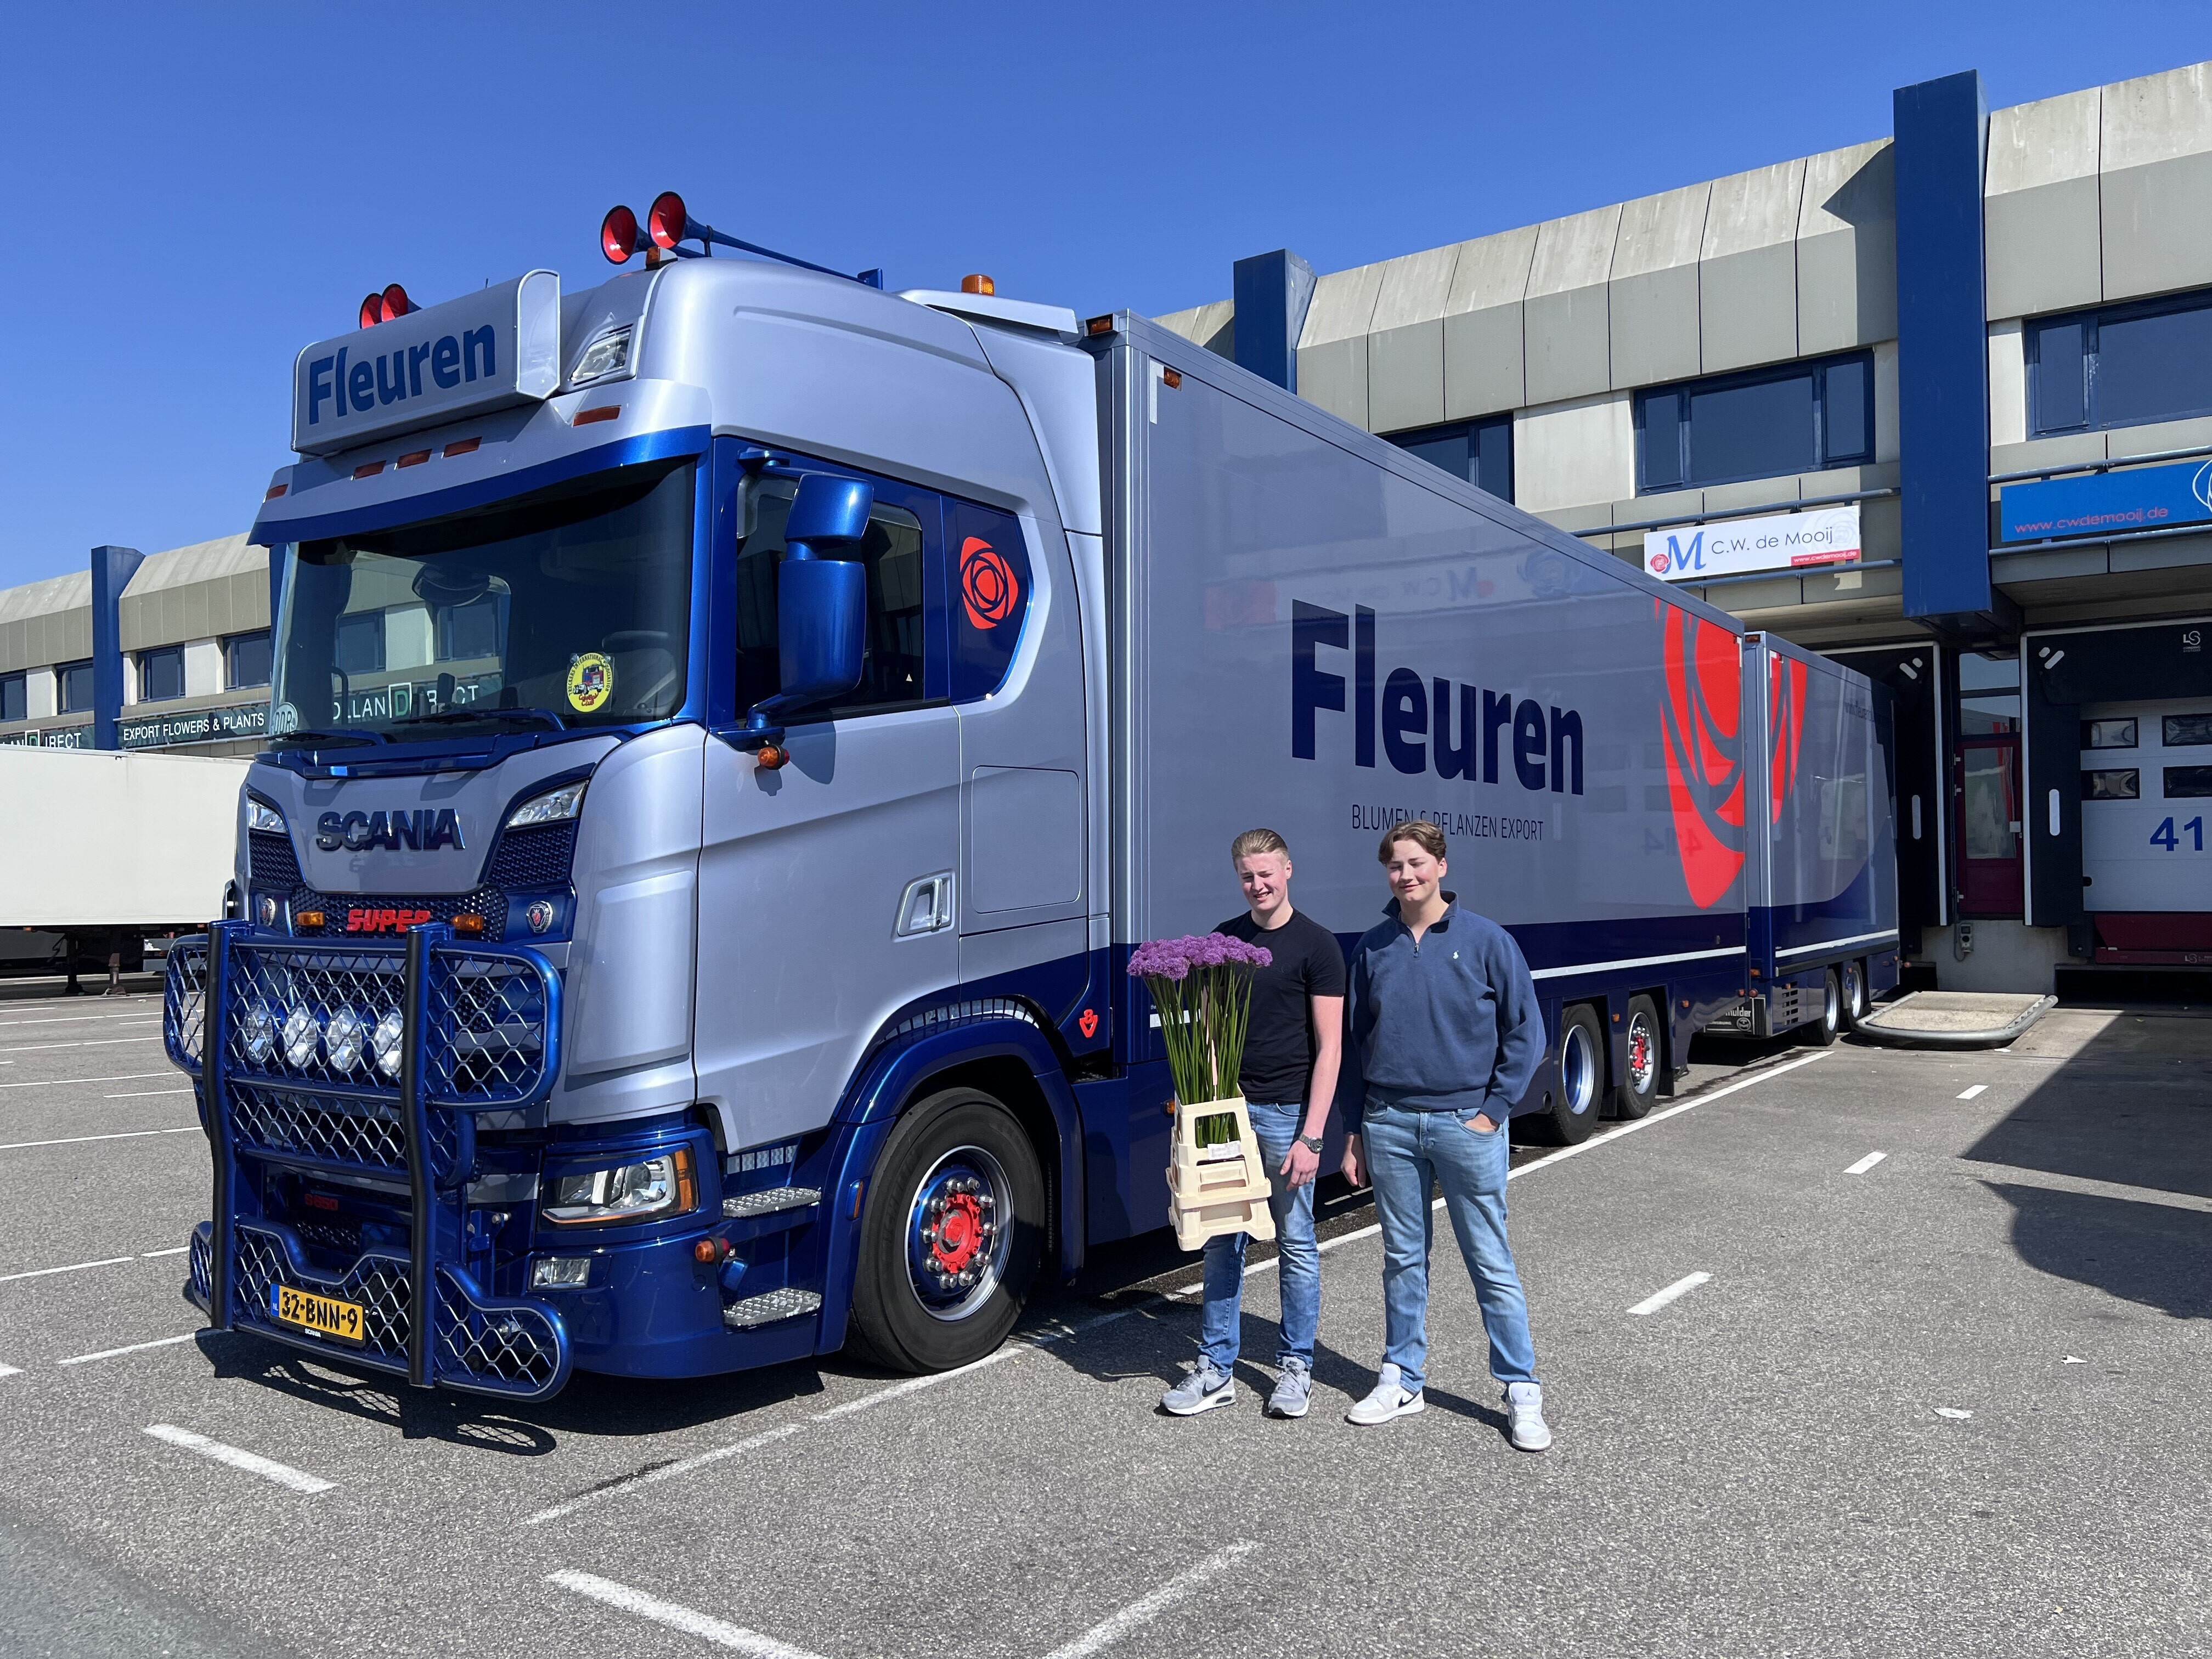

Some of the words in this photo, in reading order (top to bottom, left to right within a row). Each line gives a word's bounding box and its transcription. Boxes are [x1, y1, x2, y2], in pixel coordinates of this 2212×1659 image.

[309, 324, 496, 425] Fleuren
[2015, 506, 2169, 533] www.cwdemooij.de
[1662, 531, 1706, 574] M
[1711, 538, 1750, 554] C.W.
[1756, 534, 1779, 549] de
[1785, 527, 1833, 546] Mooij
[1292, 599, 1584, 795] Fleuren
[123, 725, 160, 741] EXPORT
[163, 719, 210, 737] FLOWERS
[213, 718, 220, 731] &
[223, 712, 264, 730] PLANTS
[316, 809, 466, 851] SCANIA
[1352, 804, 1414, 831] BLUMEN
[1434, 811, 1497, 838] PFLANZEN
[1501, 817, 1544, 841] EXPORT
[347, 909, 431, 932] SUPER
[282, 1291, 358, 1334] 32-BNN-9
